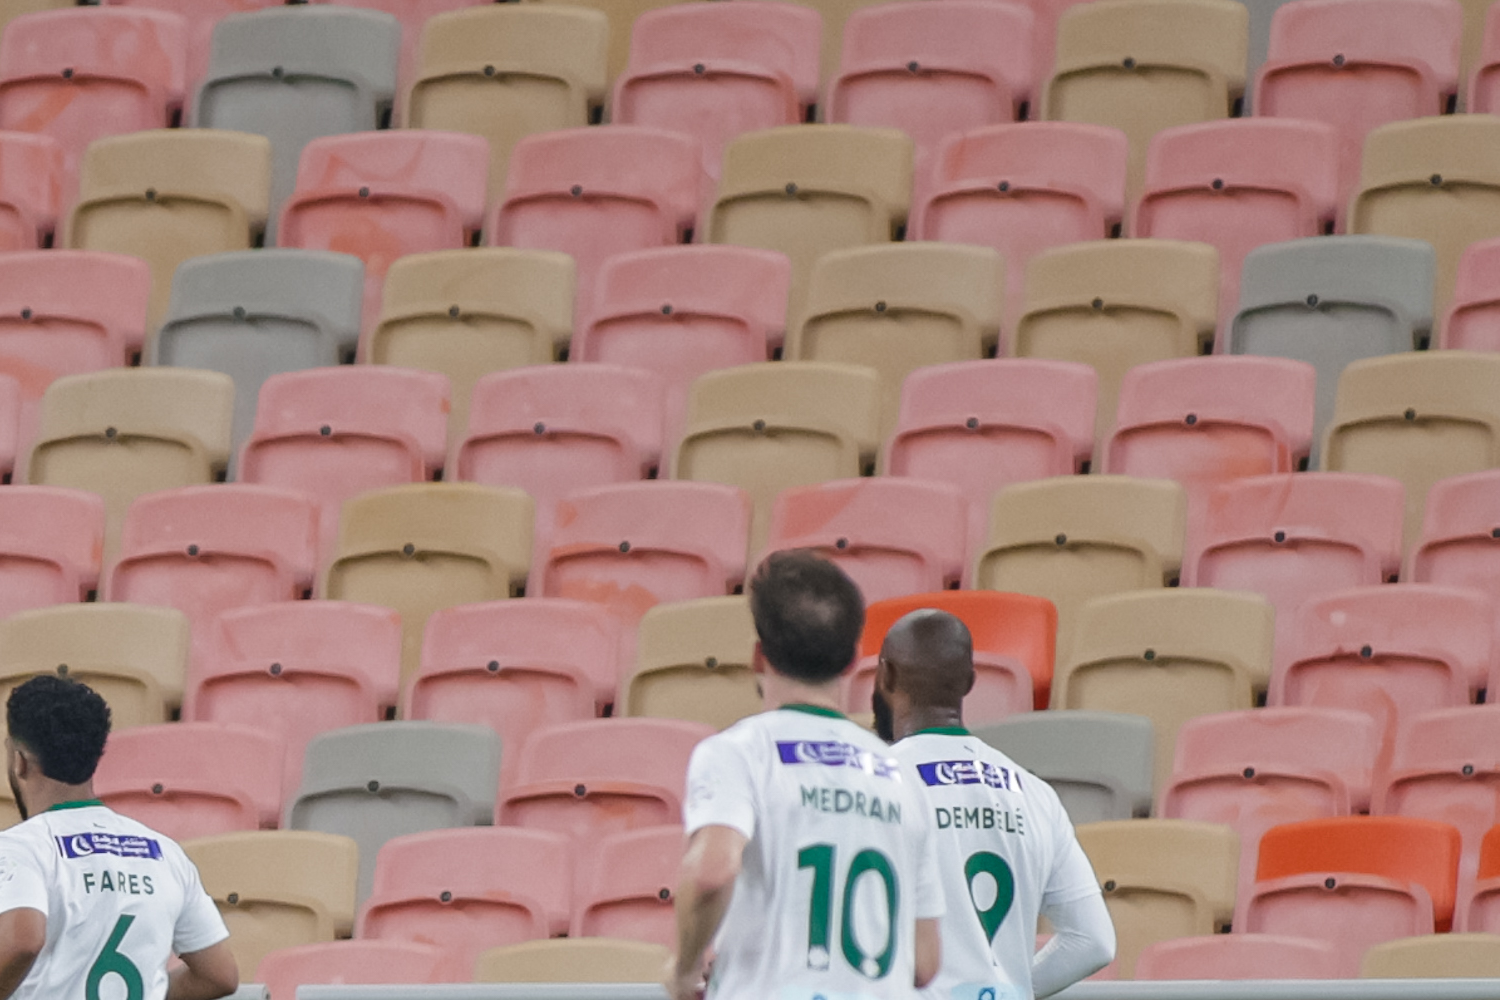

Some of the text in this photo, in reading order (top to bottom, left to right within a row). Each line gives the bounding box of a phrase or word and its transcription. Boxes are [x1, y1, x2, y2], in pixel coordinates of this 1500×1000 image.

[799, 784, 901, 824] MEDRAN
[83, 870, 154, 895] FARES
[798, 842, 898, 981] 10
[964, 850, 1015, 966] 9
